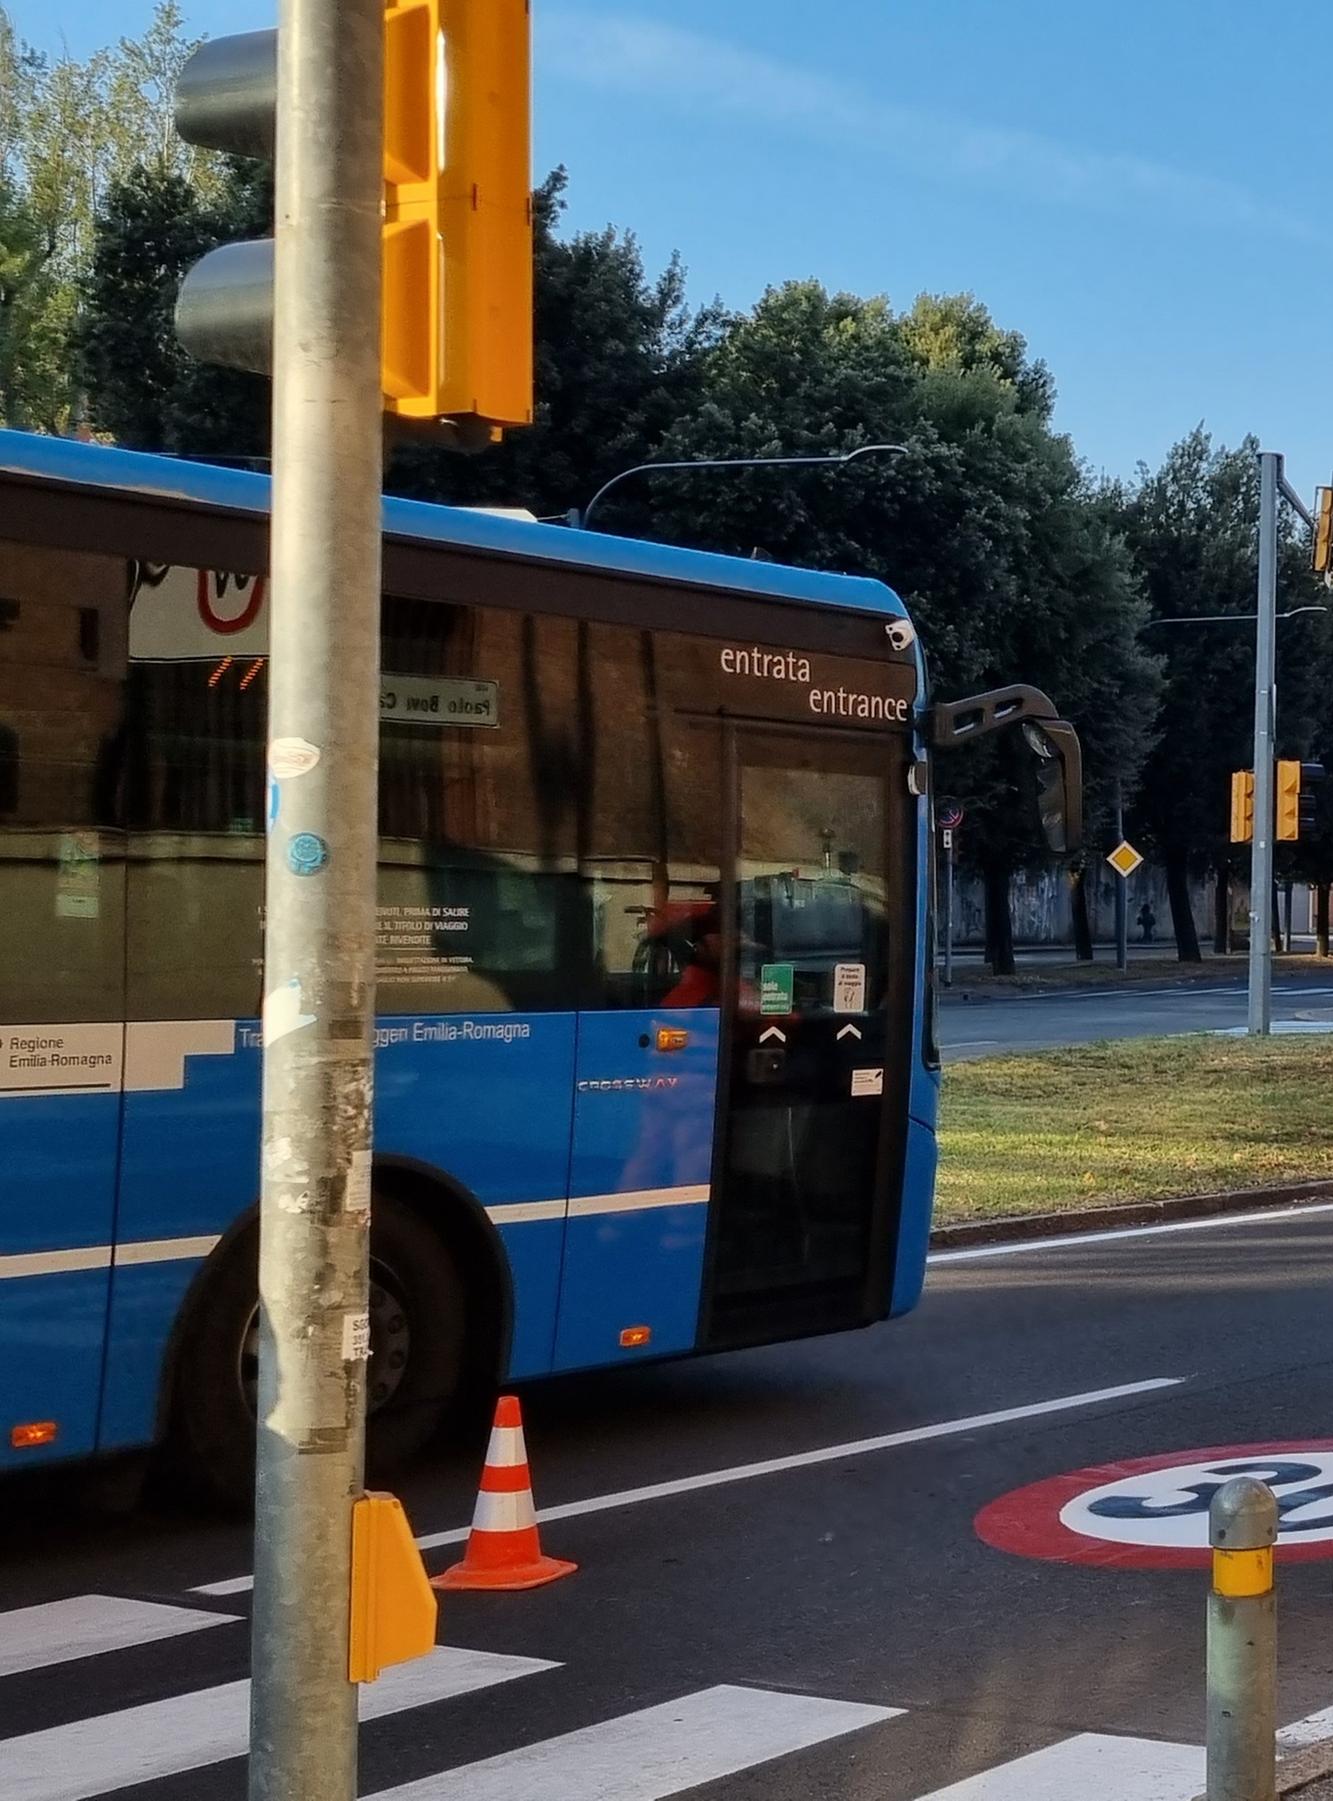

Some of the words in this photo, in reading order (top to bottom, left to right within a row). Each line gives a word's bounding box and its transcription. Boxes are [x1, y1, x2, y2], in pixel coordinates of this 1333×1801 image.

[721, 647, 810, 682] entrata
[809, 687, 907, 721] entrance
[435, 921, 468, 931] VIAGGIO
[413, 1021, 530, 1043] Emilia-Romagna
[10, 1037, 64, 1052] Regione
[9, 1054, 112, 1068] Emilia-Romagna
